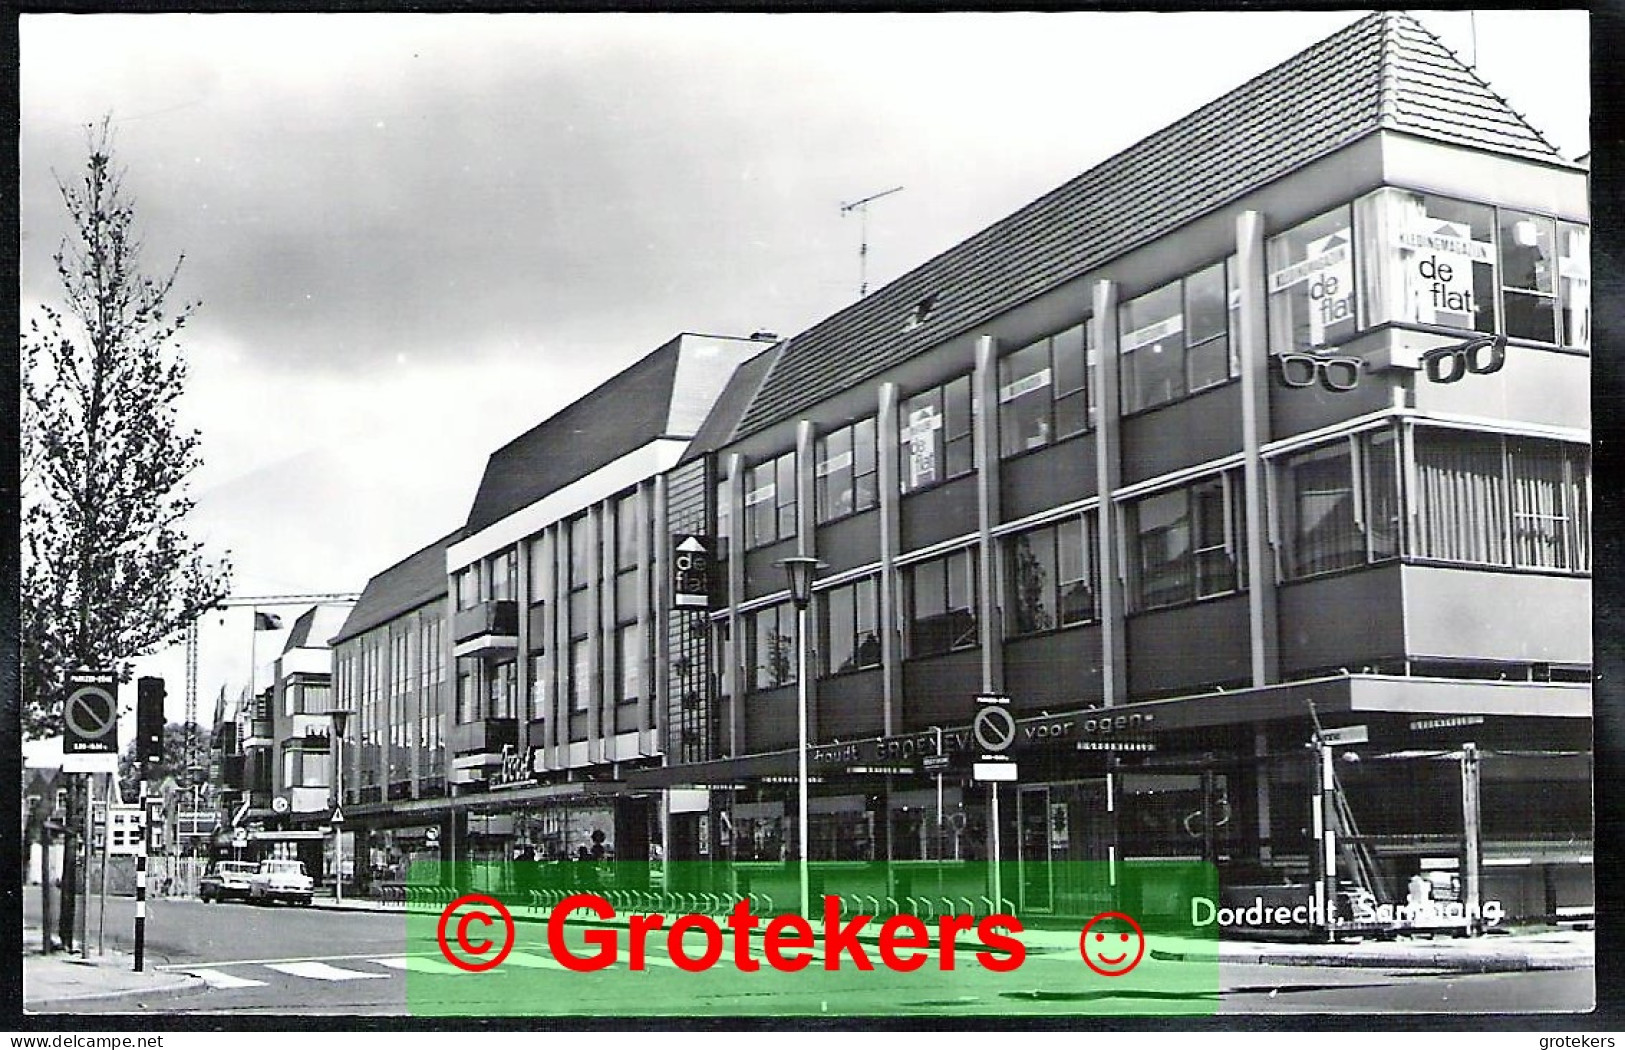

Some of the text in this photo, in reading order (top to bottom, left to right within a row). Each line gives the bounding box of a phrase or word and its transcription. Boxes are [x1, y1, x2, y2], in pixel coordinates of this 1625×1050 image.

[1419, 255, 1453, 282] de
[1311, 273, 1338, 300] de
[1429, 282, 1472, 313] flat
[677, 552, 707, 571] de
[1024, 722, 1075, 739] voor
